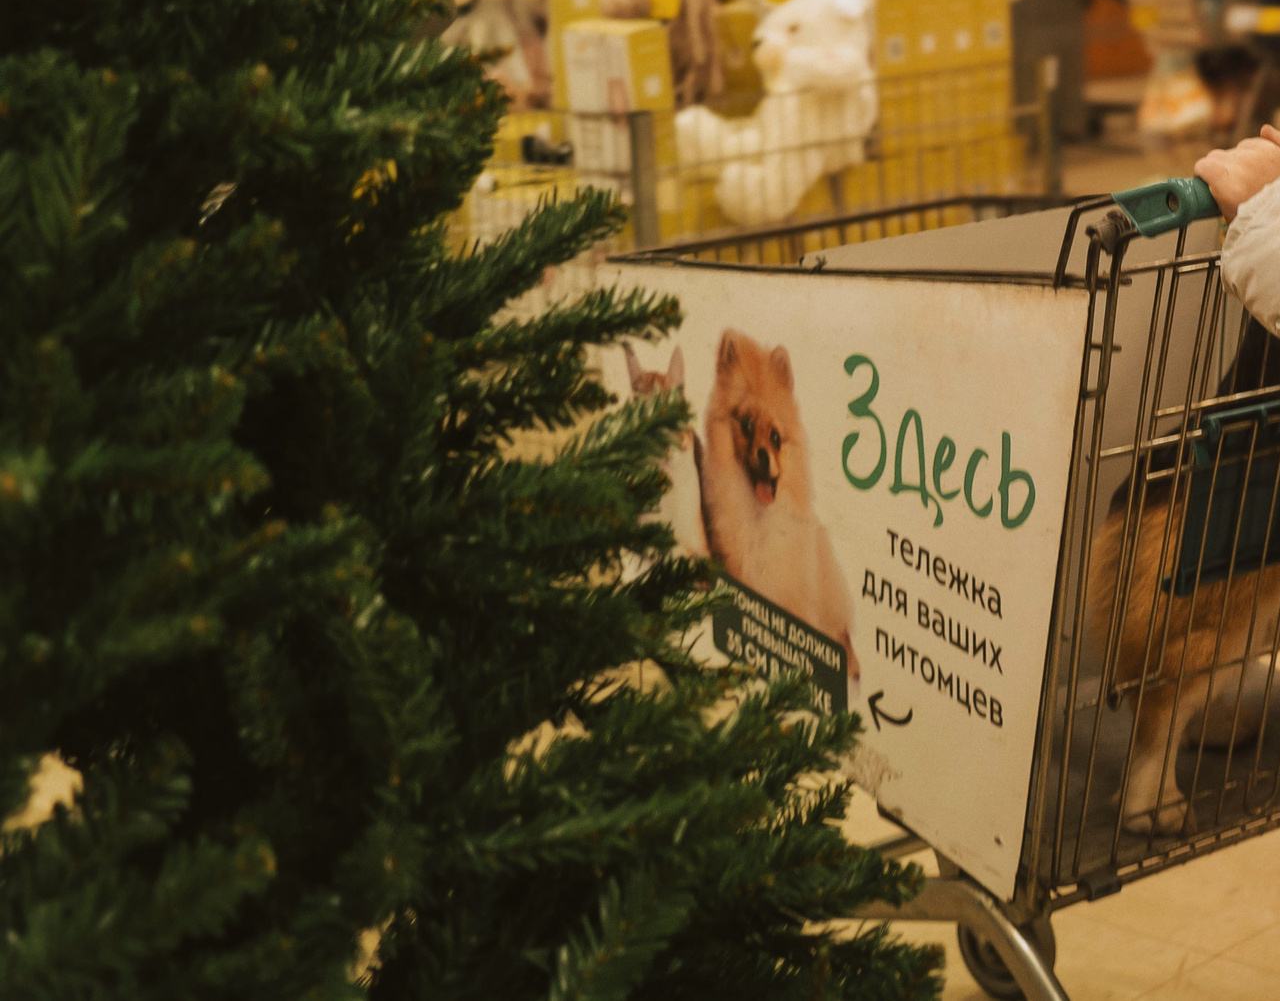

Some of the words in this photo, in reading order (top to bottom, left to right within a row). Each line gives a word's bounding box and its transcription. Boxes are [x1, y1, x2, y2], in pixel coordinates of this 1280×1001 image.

[842, 354, 1036, 529] Здесь
[863, 569, 907, 618] для
[917, 600, 1003, 675] ваших
[887, 529, 1002, 620] тележка
[744, 642, 767, 674] СМ
[771, 611, 786, 637] НЕ
[788, 623, 841, 672] ДОЛЖЕН
[876, 627, 1003, 728] питомцев
